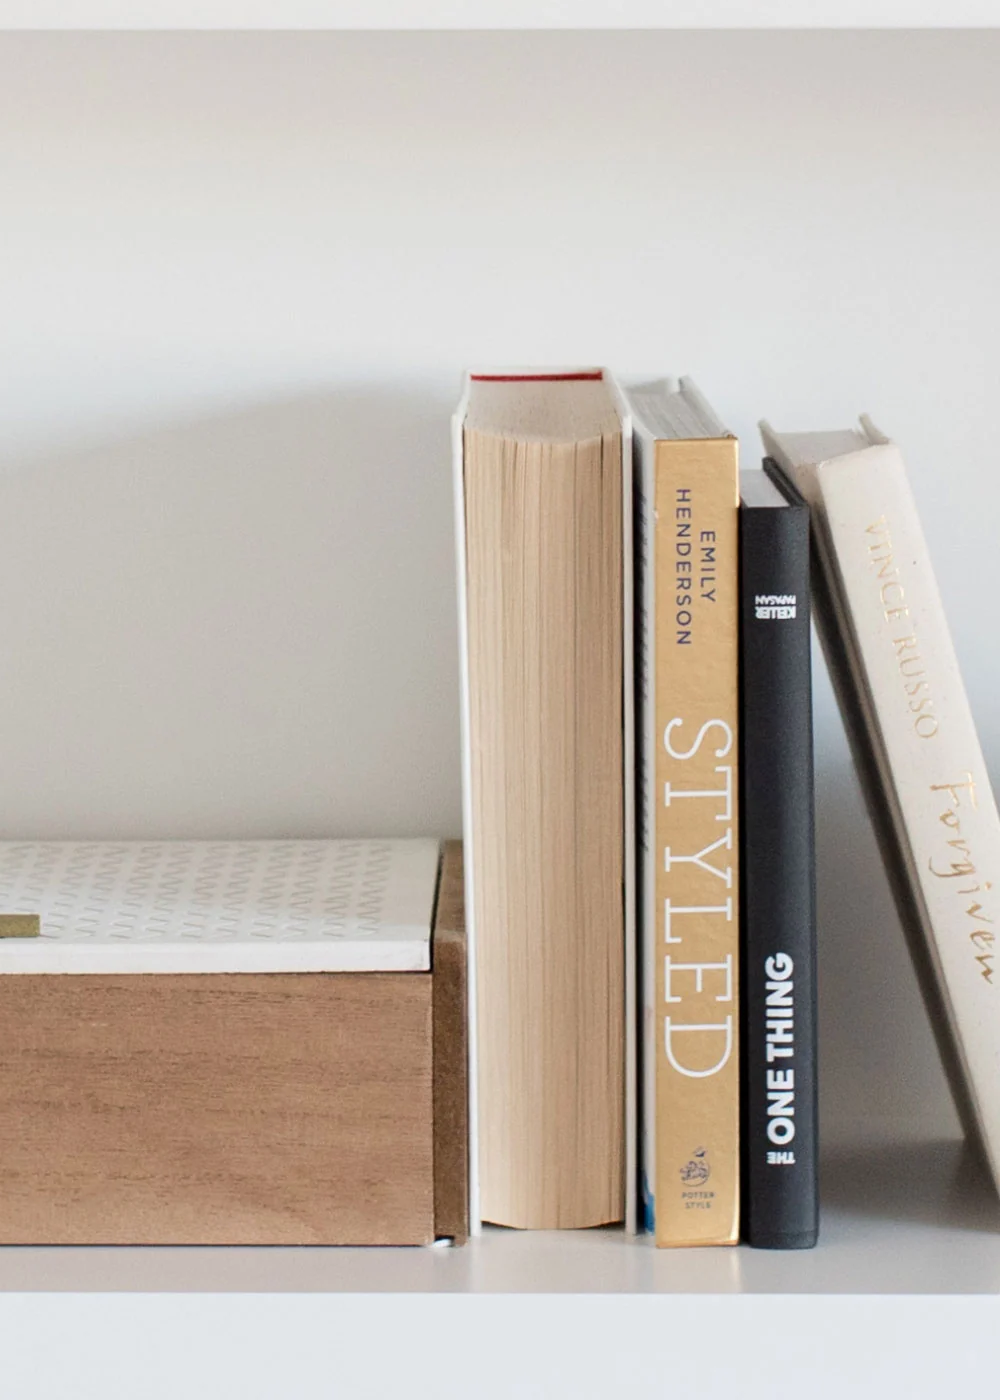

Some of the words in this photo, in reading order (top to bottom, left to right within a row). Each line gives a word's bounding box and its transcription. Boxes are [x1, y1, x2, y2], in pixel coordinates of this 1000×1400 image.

[676, 489, 692, 644] HENDERSON
[700, 530, 716, 602] EMILY
[754, 605, 797, 619] KELLER
[864, 514, 910, 624] VINCE
[892, 632, 940, 739] RUSSO
[663, 717, 733, 1078] STYLED
[928, 769, 996, 985] Forgiven
[764, 952, 794, 1063] THING
[766, 1069, 795, 1146] ONE
[681, 1191, 715, 1199] POTTER
[766, 1151, 796, 1165] THE
